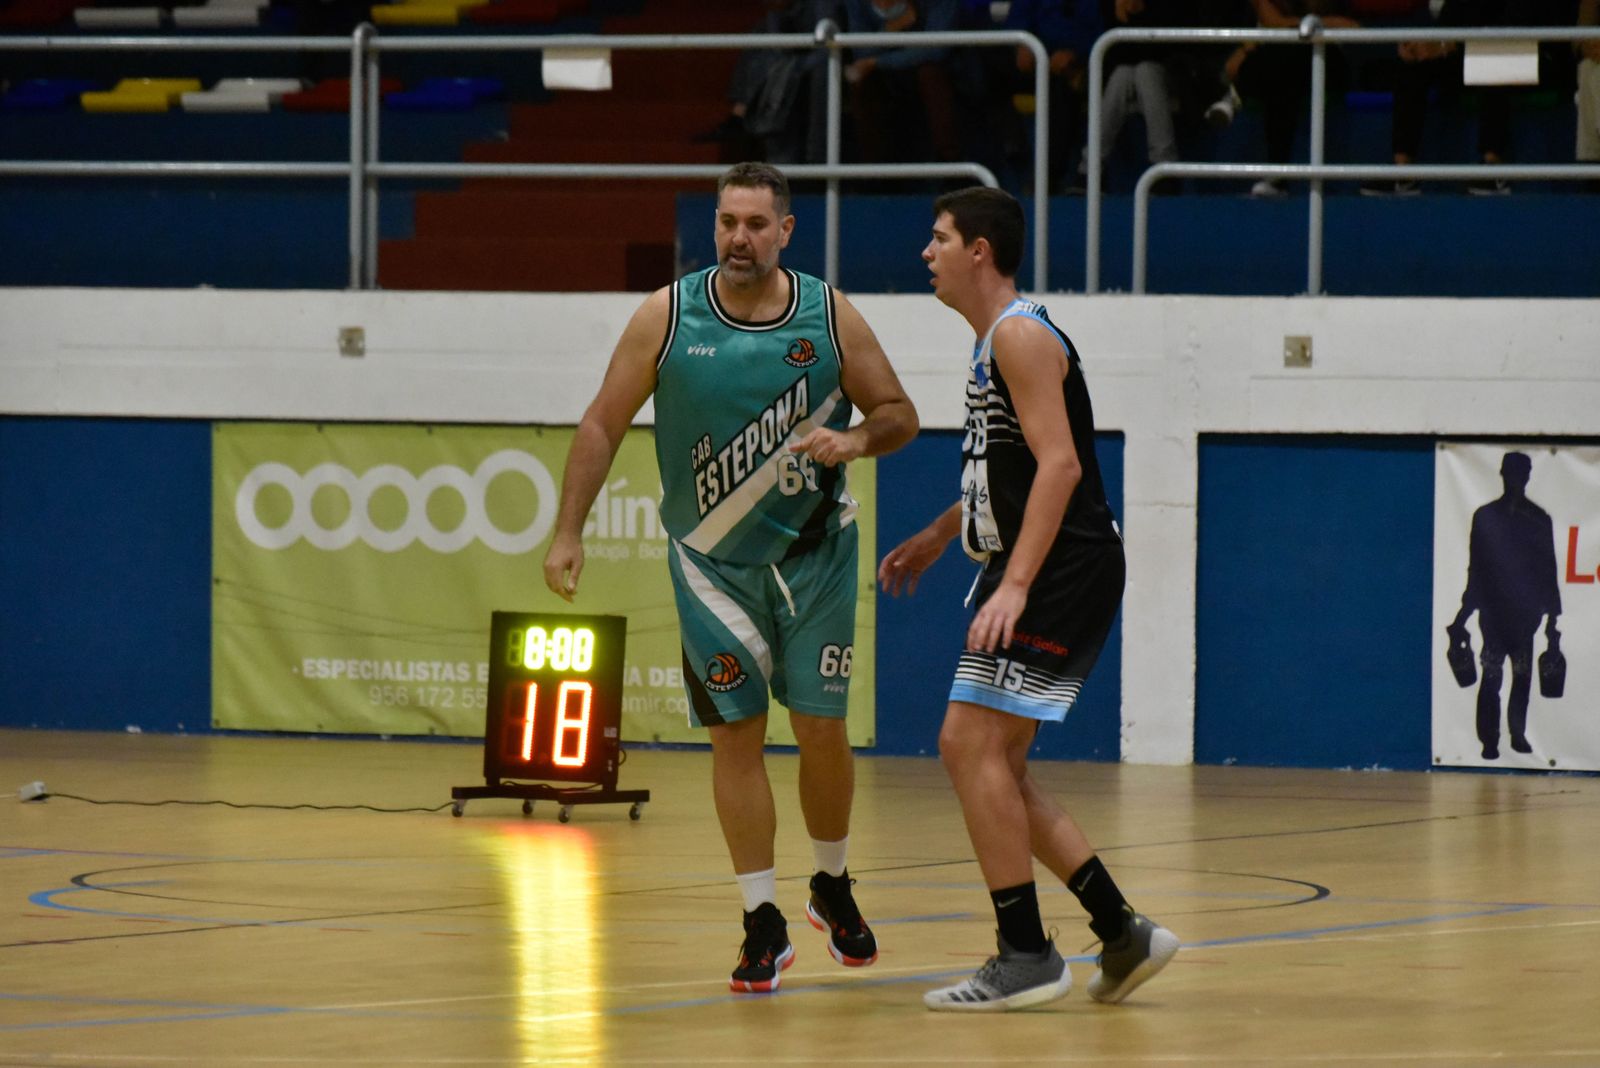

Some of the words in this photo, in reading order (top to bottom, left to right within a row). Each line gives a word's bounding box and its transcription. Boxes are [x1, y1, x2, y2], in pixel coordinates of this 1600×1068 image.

[691, 434, 712, 470] CAB
[695, 372, 809, 518] ESTEPONA
[1566, 526, 1600, 584] L
[524, 626, 595, 672] 8:00
[819, 643, 854, 679] 66
[302, 658, 472, 683] ESPECIALISTAS
[705, 673, 748, 692] ESTEPONA
[993, 658, 1026, 693] 15
[416, 686, 455, 708] 172
[523, 681, 592, 766] 18
